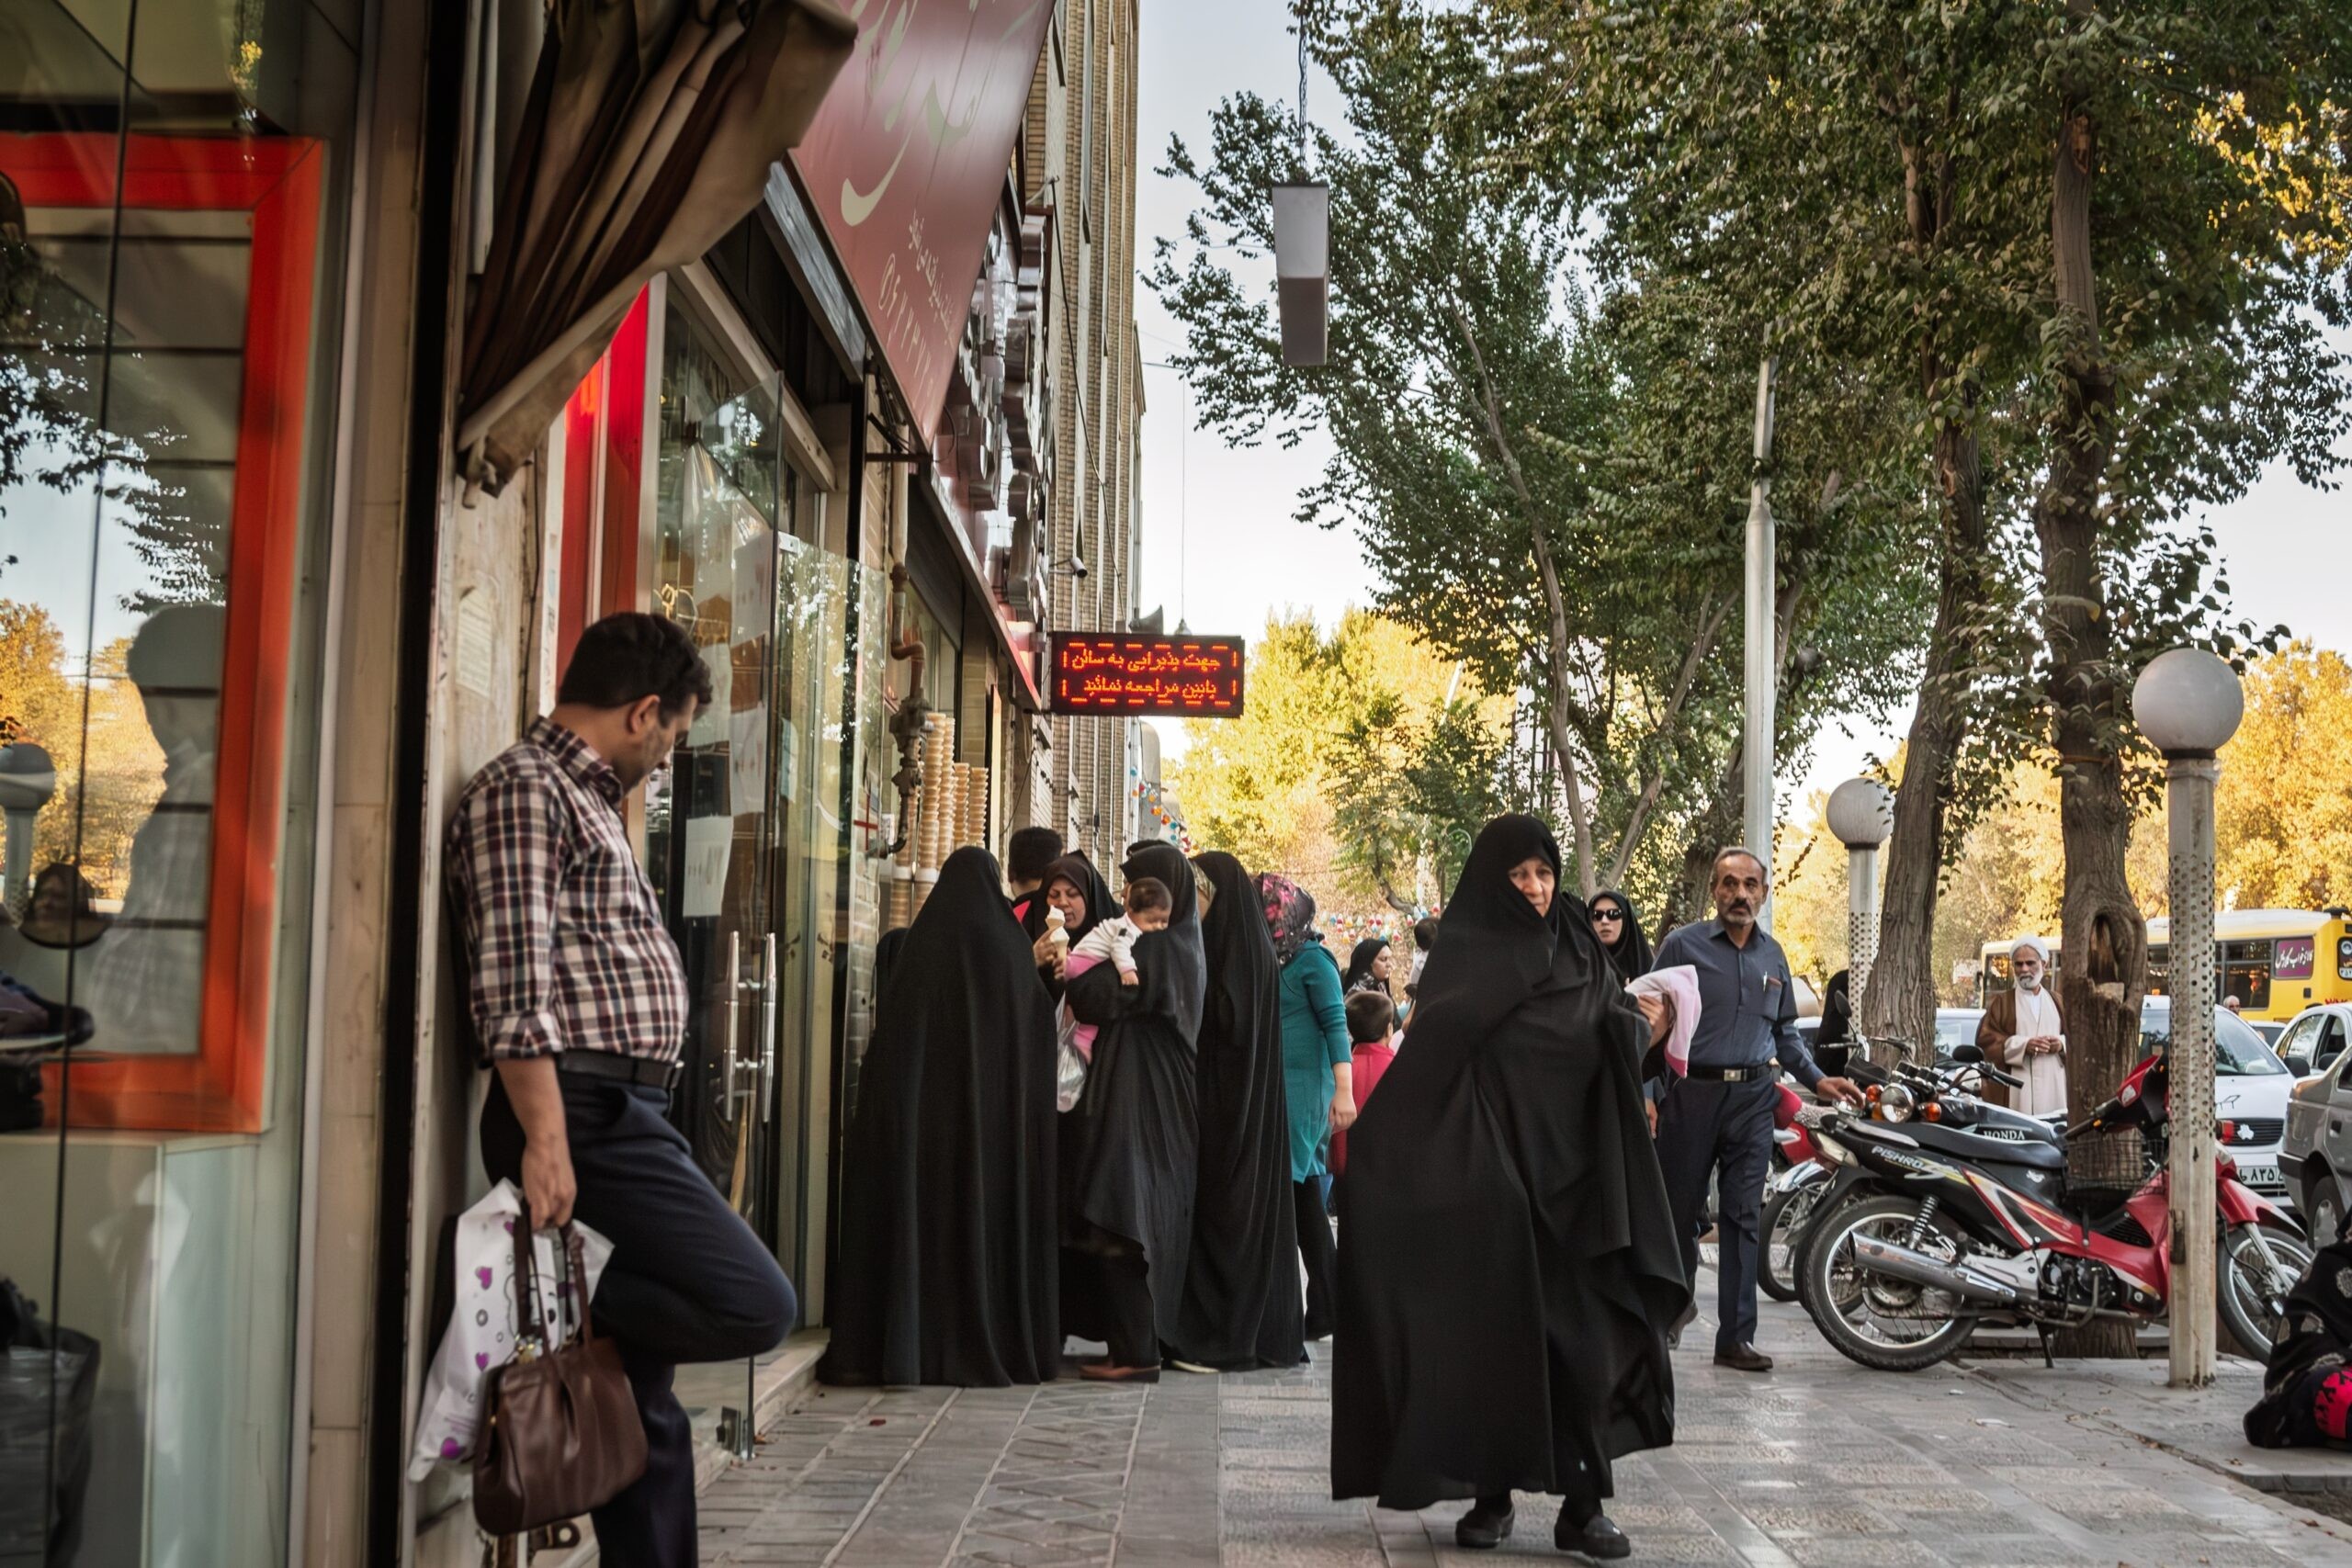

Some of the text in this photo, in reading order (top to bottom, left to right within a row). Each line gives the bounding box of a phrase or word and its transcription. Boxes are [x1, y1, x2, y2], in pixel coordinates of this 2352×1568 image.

[1071, 649, 1221, 671] جهت پذیرایی به سالن
[1125, 678, 1180, 698] مراجعه
[1984, 1130, 2025, 1140] HONDA
[1871, 1145, 1925, 1170] PISHRO
